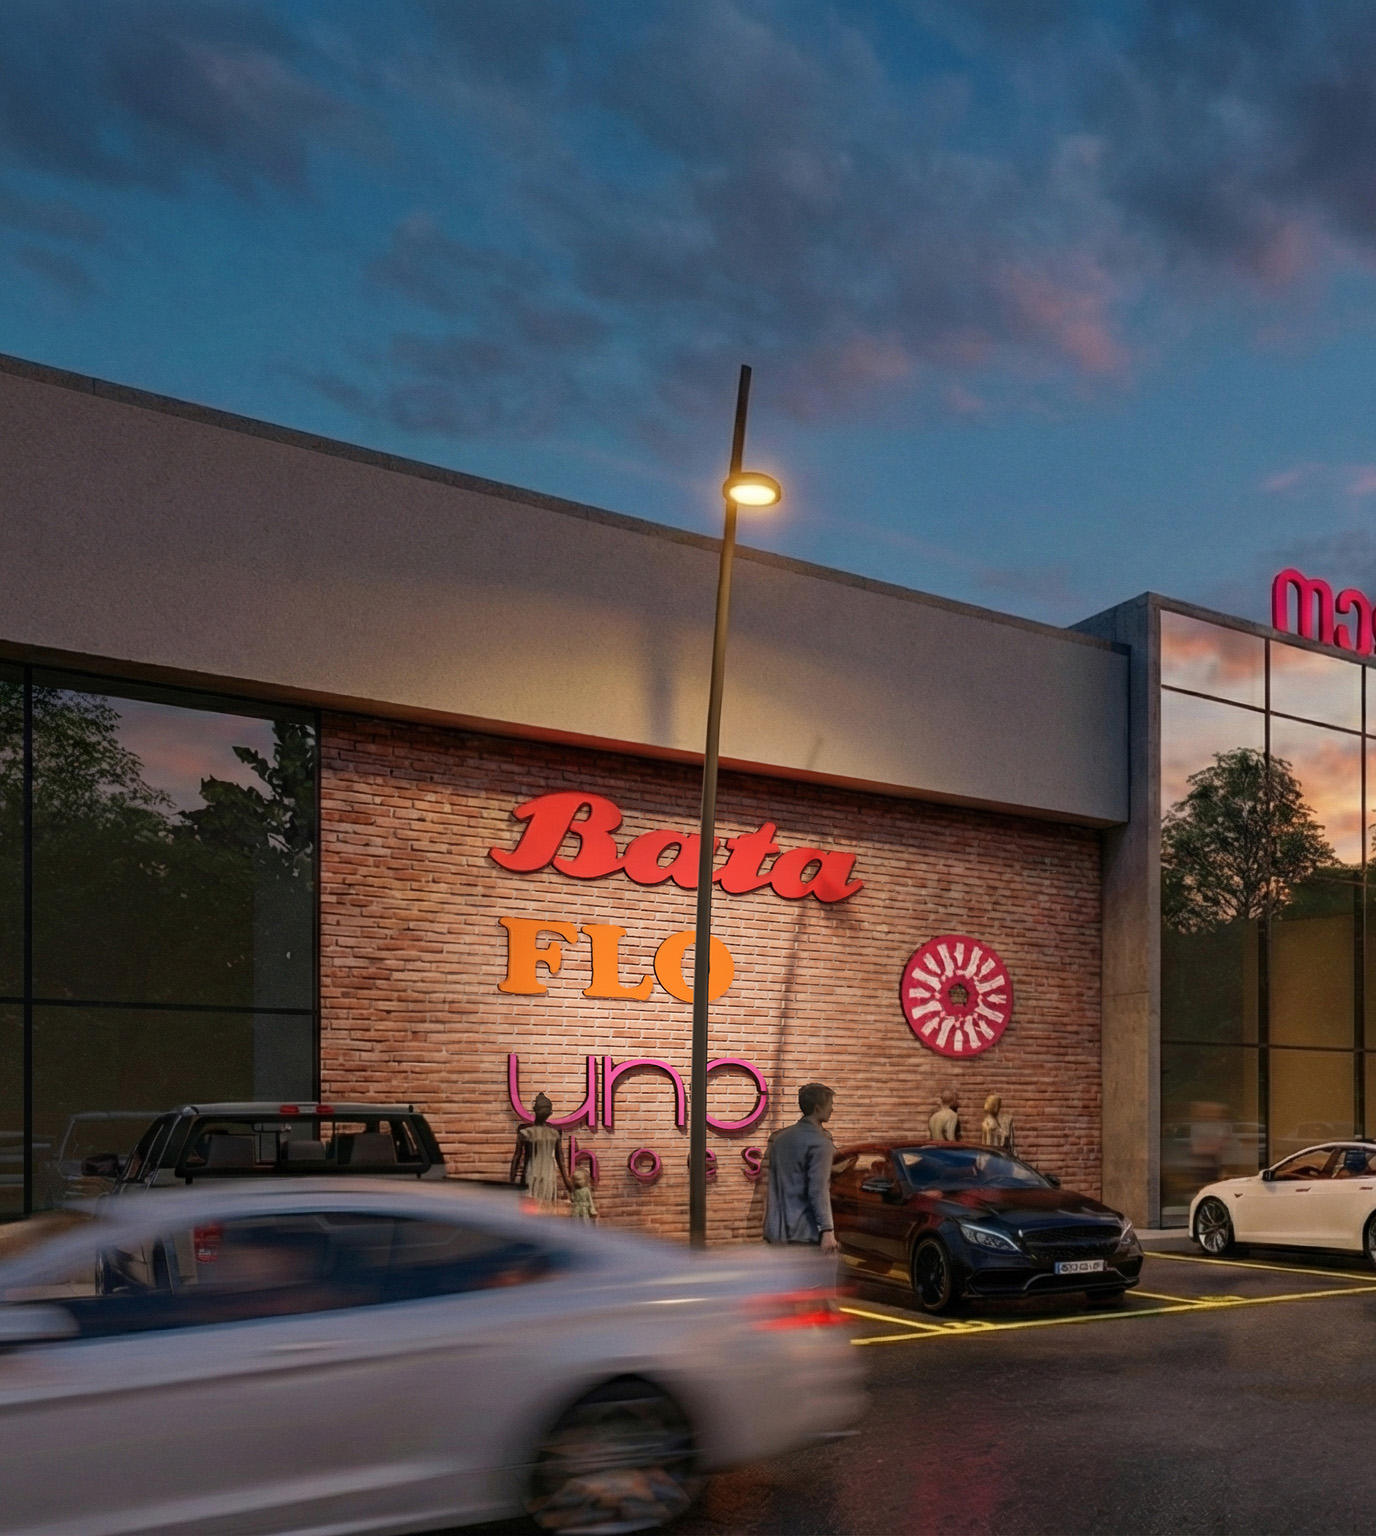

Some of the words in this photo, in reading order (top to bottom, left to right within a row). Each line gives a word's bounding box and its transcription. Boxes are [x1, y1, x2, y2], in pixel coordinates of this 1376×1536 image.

[490, 791, 864, 902] Bata
[499, 917, 735, 1003] FLO
[508, 1053, 768, 1130] uno
[519, 1136, 762, 1179] hos
